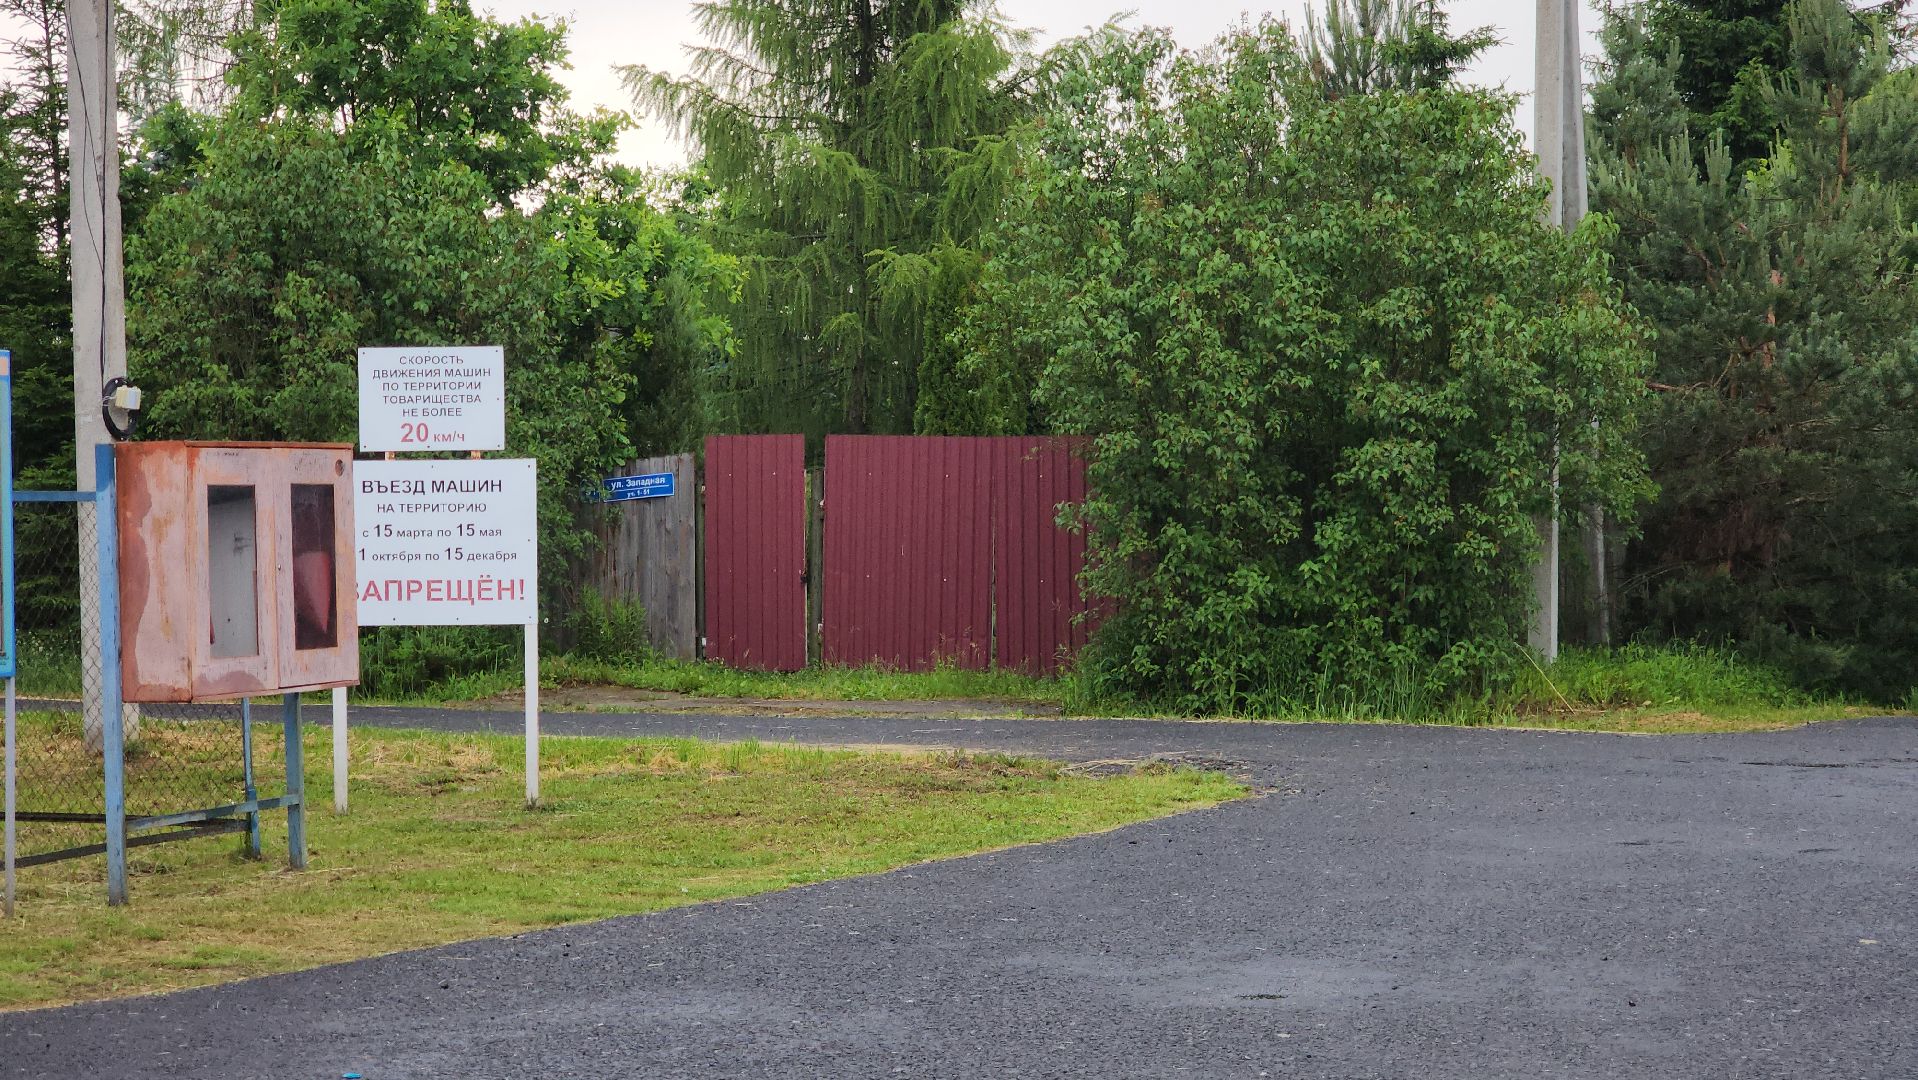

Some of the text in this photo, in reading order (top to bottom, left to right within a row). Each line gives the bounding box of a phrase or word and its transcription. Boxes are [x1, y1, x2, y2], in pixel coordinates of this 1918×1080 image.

[400, 355, 464, 365] СКОРОСТЬ
[373, 368, 491, 379] ДВИЖЕНИЯ МАШИН
[382, 381, 482, 391] ПО ТЕРРИТОРИИ
[383, 394, 482, 405] ТОВАРИЩЕСТВА
[402, 407, 462, 417] НЕ БОЛЕЕ
[401, 422, 429, 443] 20
[361, 480, 502, 495] ВЪЕЗД МАШИН
[611, 477, 666, 490] ул. Западная
[377, 503, 487, 513] НА ТЕРРИТОРИЮ
[362, 523, 502, 539] с 15 марта по 15 мая
[359, 547, 517, 563] 1 октября по 15 декабря
